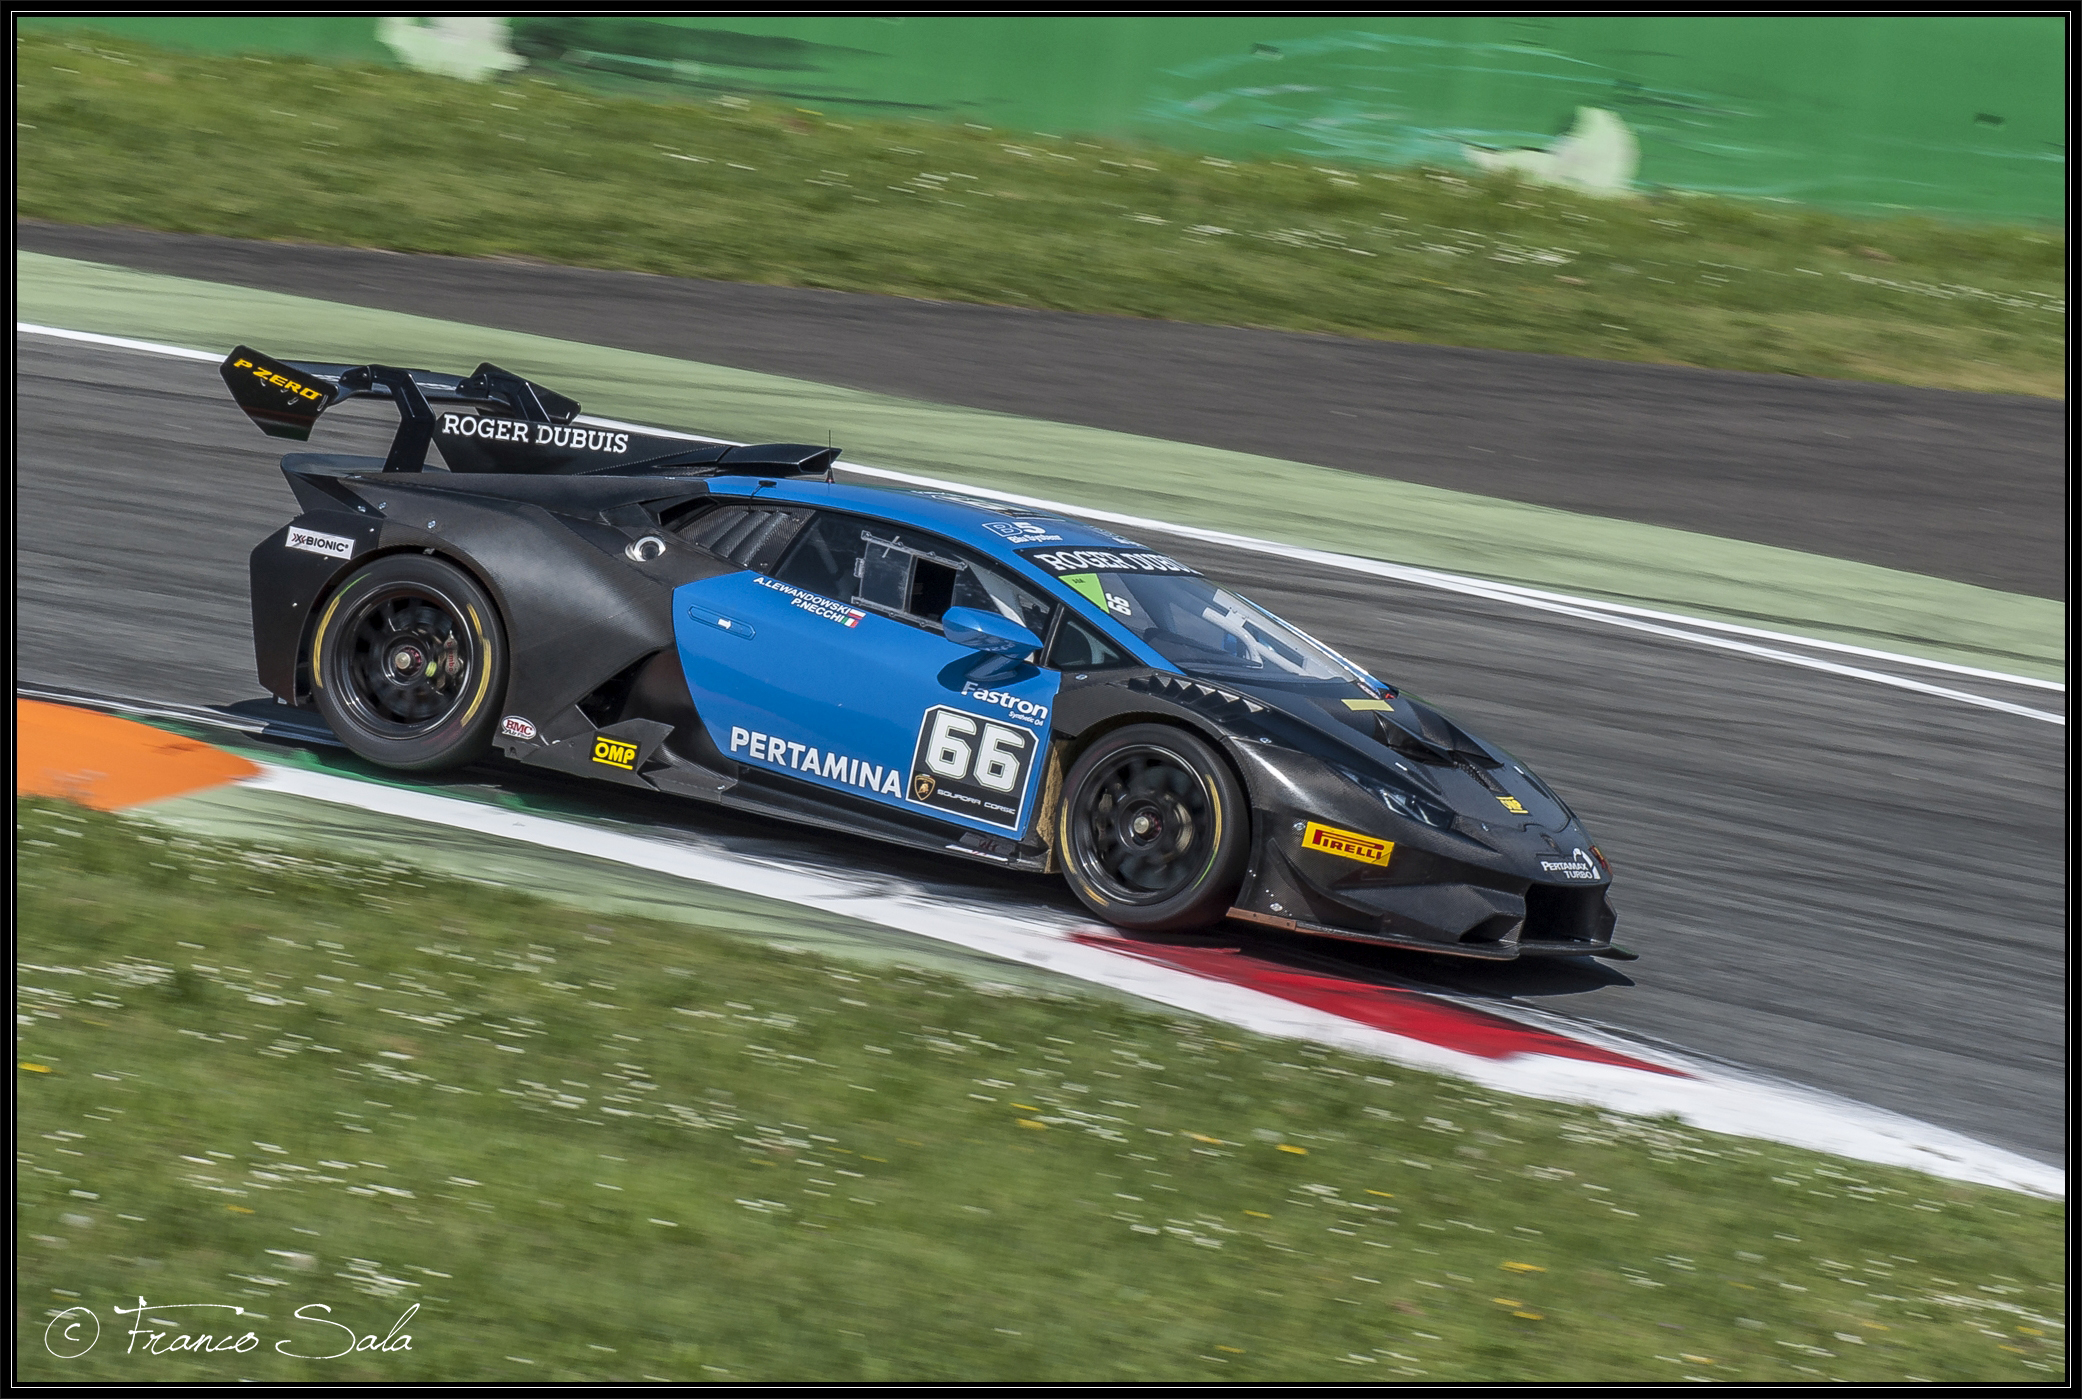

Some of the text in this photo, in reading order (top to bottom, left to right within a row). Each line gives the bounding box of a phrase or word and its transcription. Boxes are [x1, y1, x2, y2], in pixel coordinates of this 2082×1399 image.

[233, 358, 322, 401] P ZERO
[442, 413, 629, 454] ROGER DUBUIS
[1033, 550, 1138, 571] ROGER
[753, 576, 851, 615] A.LEWANDOWSKI
[790, 597, 845, 623] P.NECCHI
[960, 680, 1049, 720] Fastron
[505, 719, 533, 736] BMC
[594, 742, 636, 764] OMP
[730, 726, 902, 799] PERTAMINA
[925, 709, 1026, 793] 66
[1312, 828, 1385, 861] PIRELLI
[1540, 861, 1589, 872] PERTAMAX
[1563, 870, 1593, 879] TURBO
